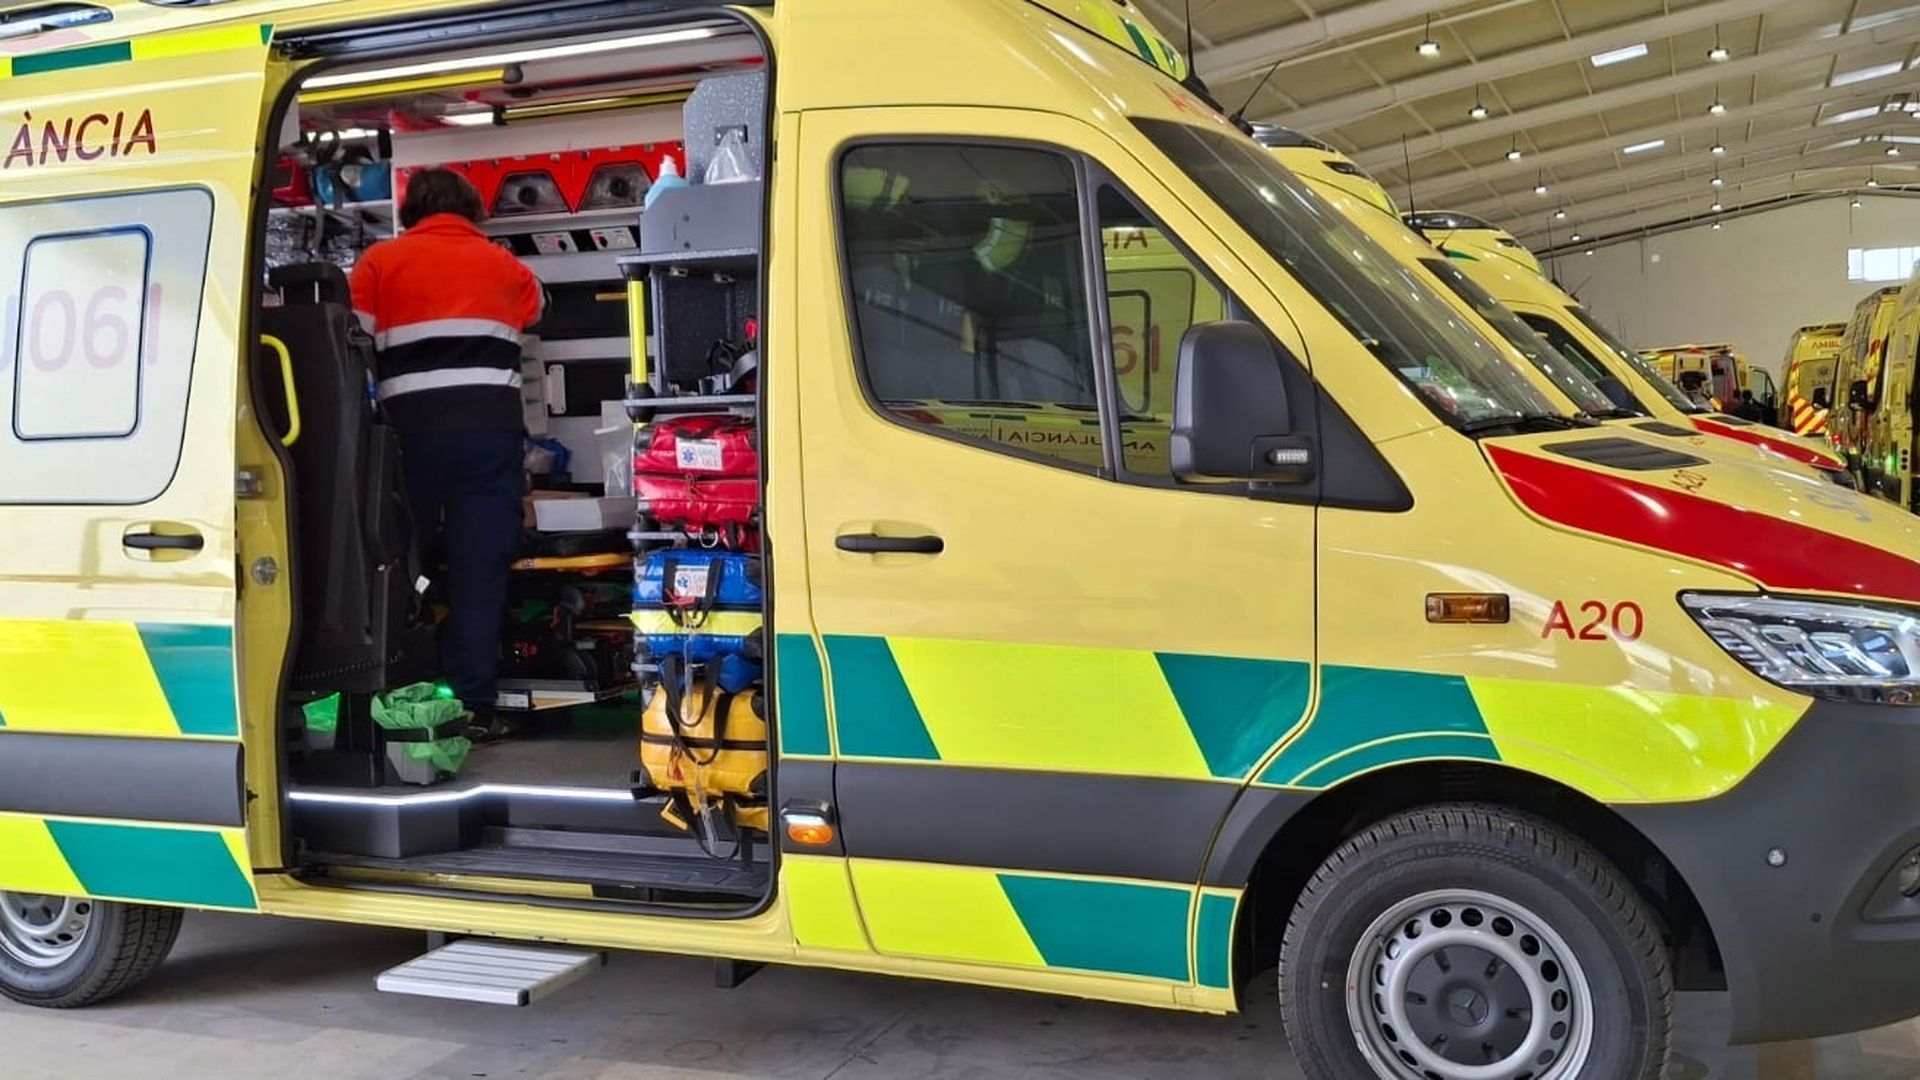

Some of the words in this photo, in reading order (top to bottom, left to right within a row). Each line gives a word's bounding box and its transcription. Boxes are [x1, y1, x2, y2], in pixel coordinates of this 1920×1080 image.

[3, 108, 156, 169] ÀNCIA
[1103, 230, 1148, 249] IA
[1541, 599, 1644, 642] A20
